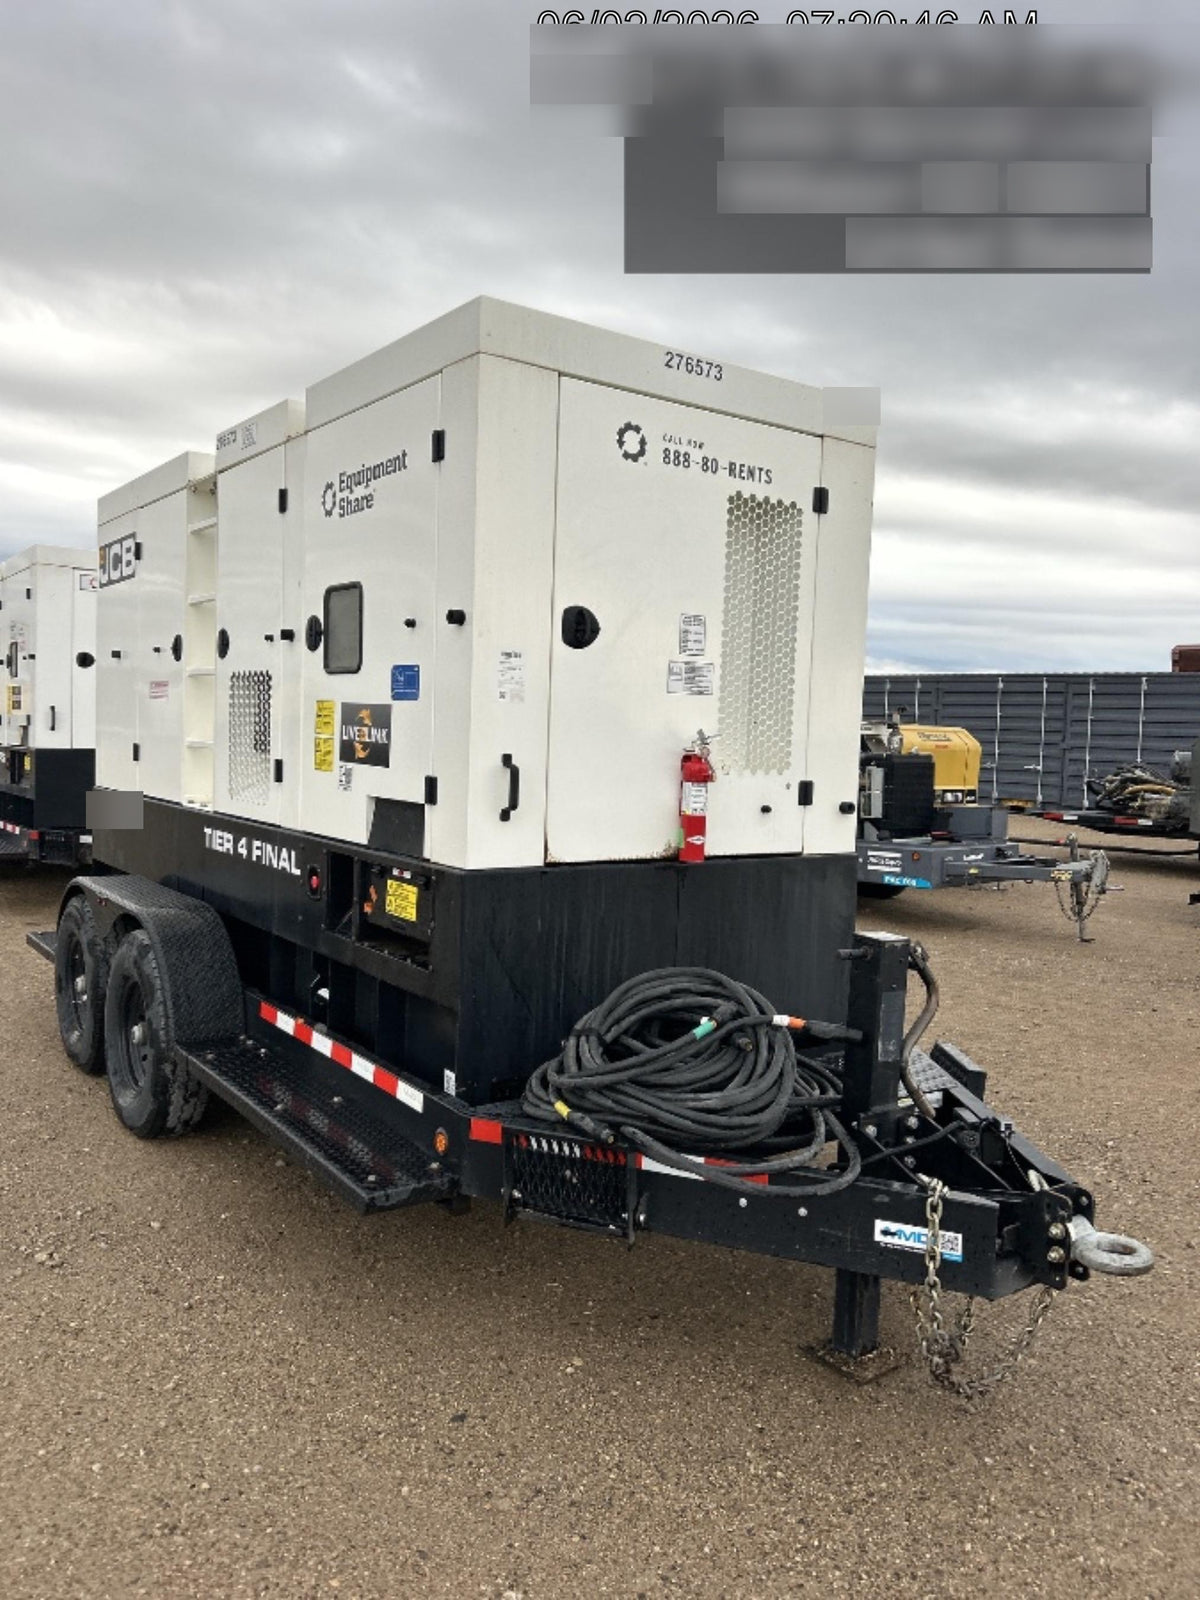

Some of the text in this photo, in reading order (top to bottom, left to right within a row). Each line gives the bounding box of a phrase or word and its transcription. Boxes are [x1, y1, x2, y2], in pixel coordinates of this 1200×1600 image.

[664, 351, 724, 381] 276573
[338, 449, 408, 494] Equipment
[662, 447, 773, 485] 888-80-RENTS
[338, 493, 374, 518] Share
[99, 536, 136, 586] JCB
[203, 826, 302, 876] TIER 4 FINAL
